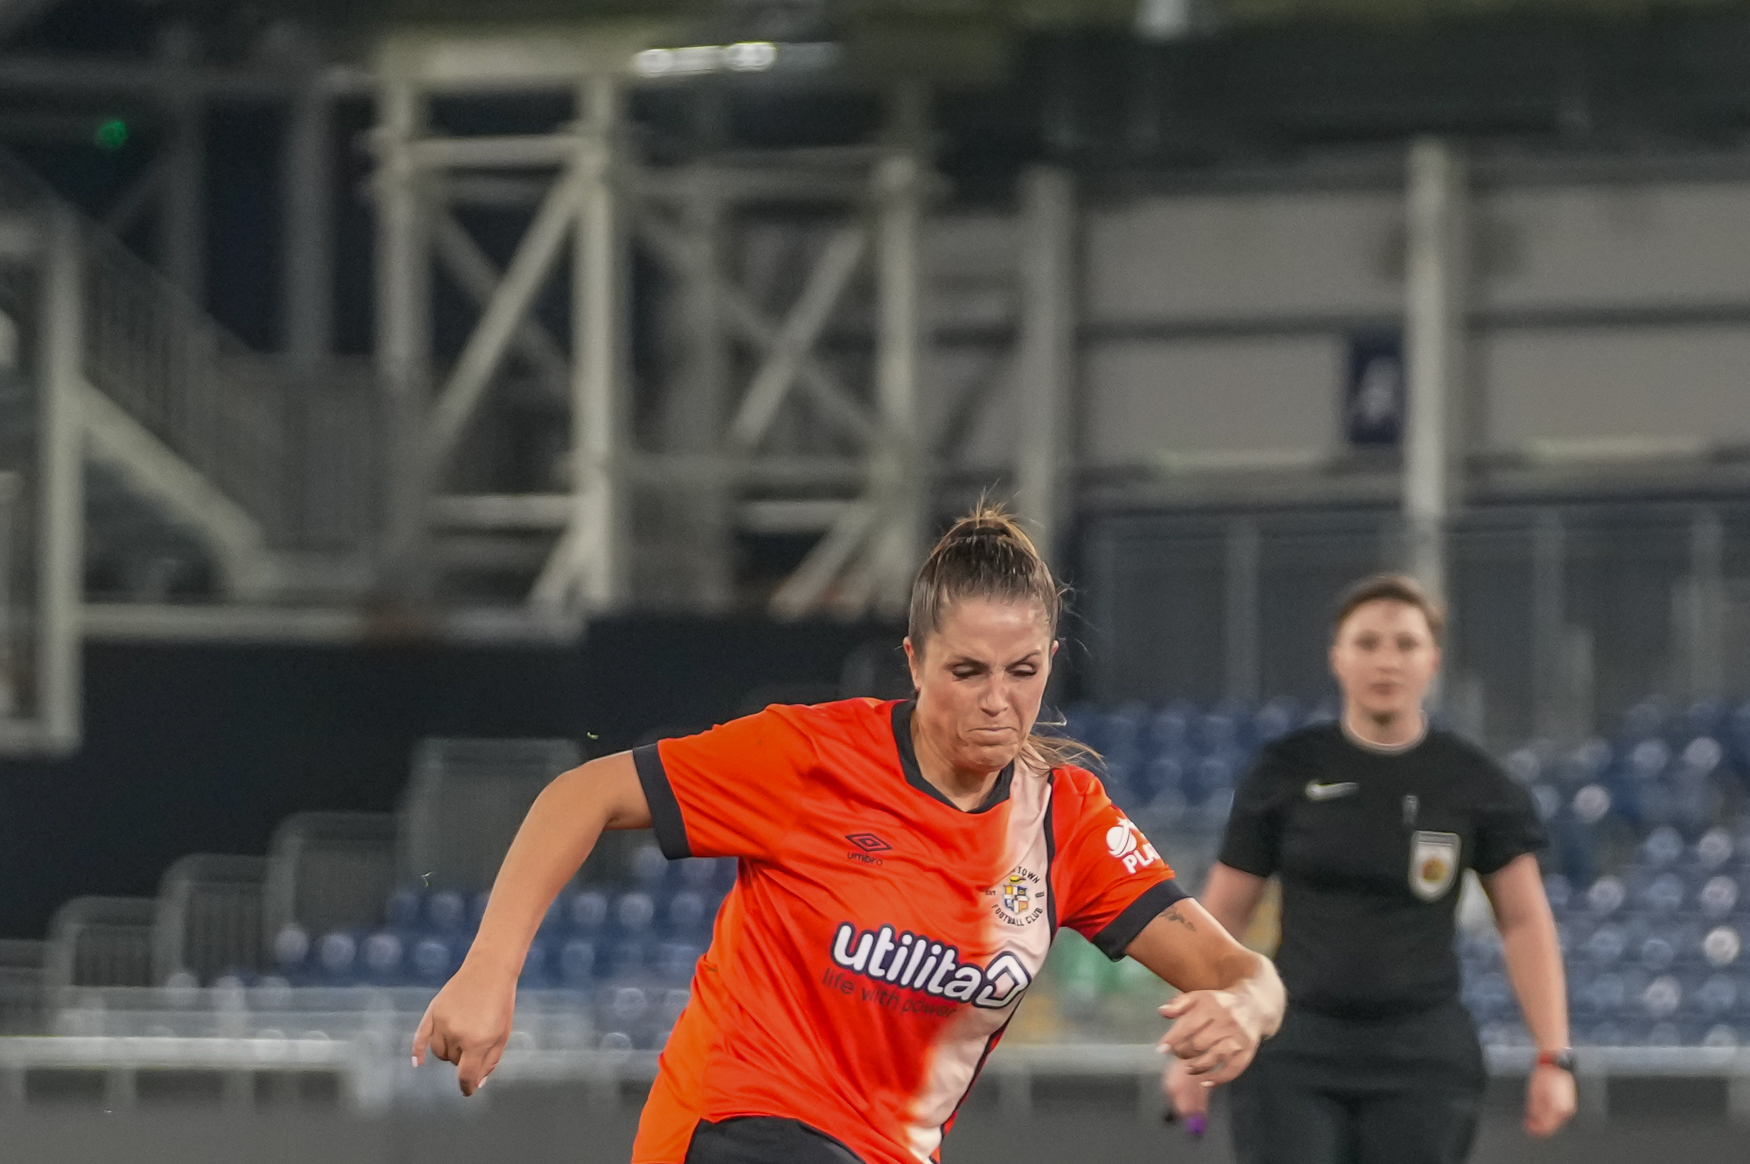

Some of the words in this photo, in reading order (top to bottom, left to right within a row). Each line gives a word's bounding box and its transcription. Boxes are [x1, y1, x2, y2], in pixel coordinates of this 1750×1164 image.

[847, 852, 883, 866] umbro
[1018, 866, 1041, 884] TOWN
[991, 904, 1024, 926] FOOTBALL
[1025, 907, 1043, 924] CLUB
[831, 922, 983, 1002] utilita
[822, 966, 854, 994] life
[862, 984, 899, 1009] with
[902, 999, 957, 1017] power
